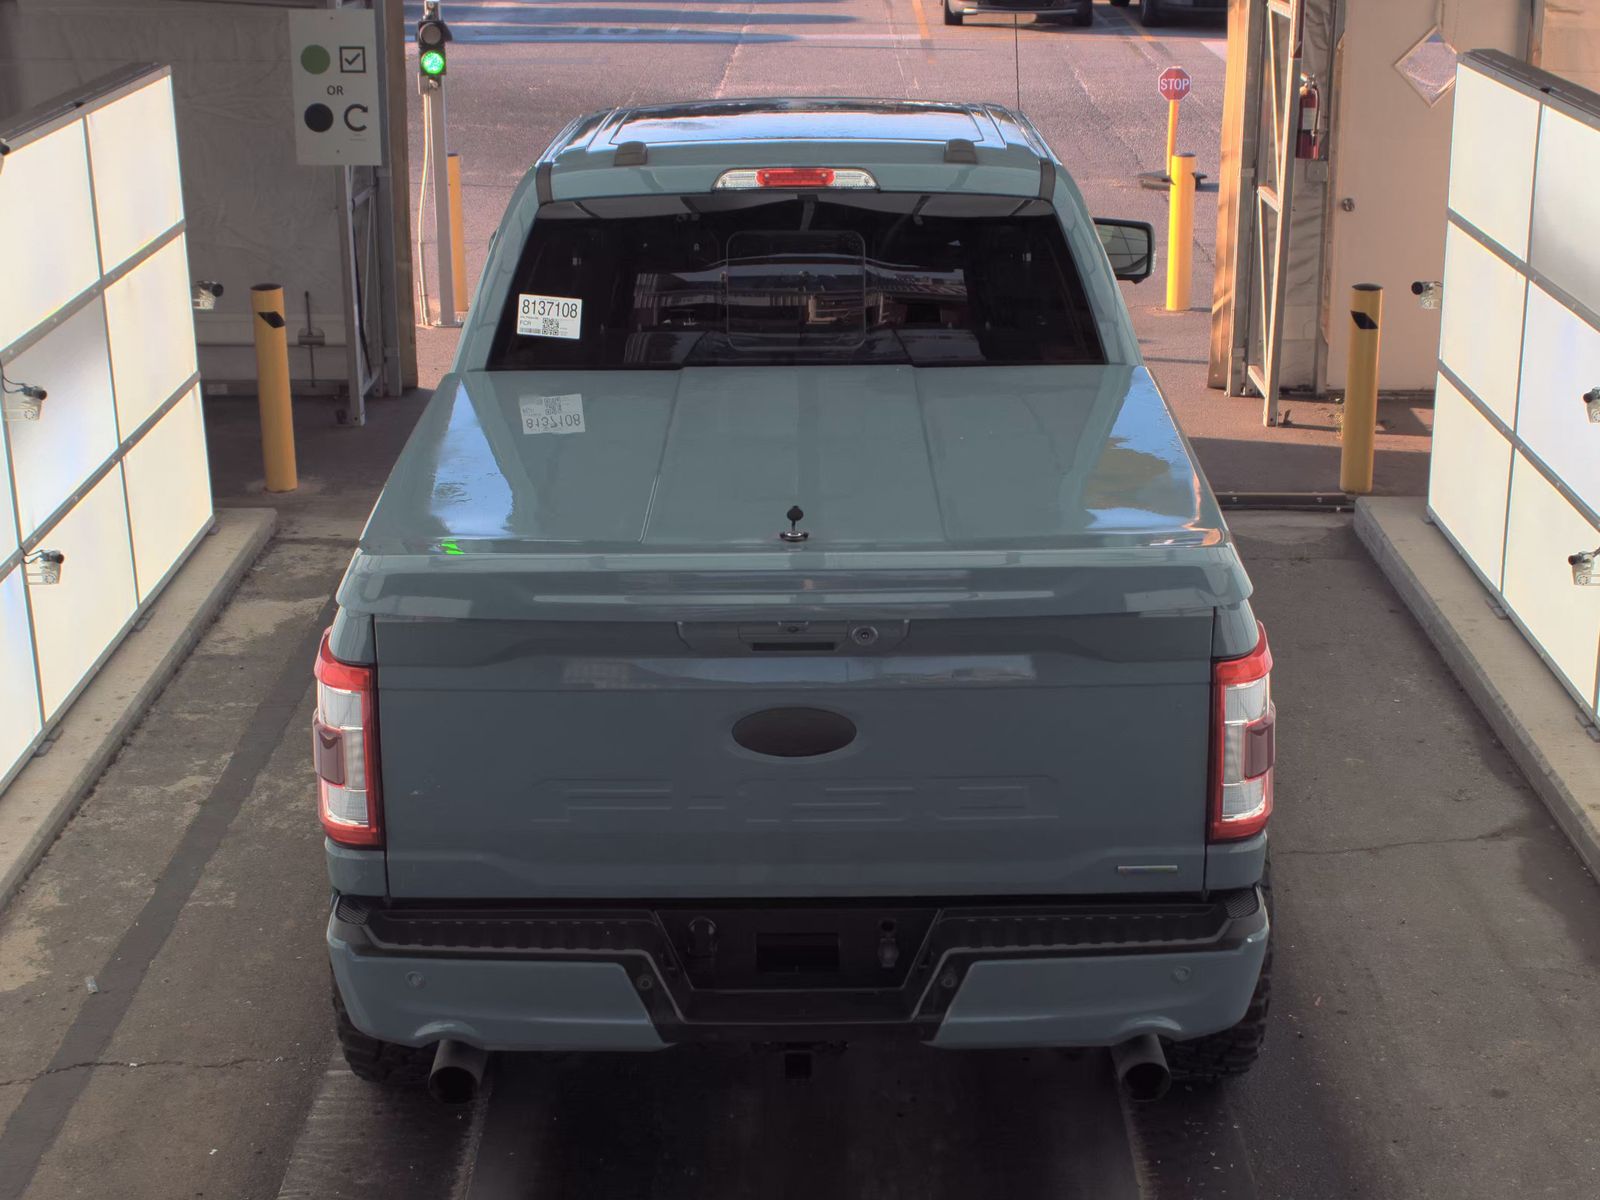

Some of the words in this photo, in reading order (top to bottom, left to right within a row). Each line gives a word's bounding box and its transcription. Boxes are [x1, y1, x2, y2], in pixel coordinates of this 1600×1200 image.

[326, 84, 344, 96] OR
[1160, 78, 1190, 91] STOP
[522, 299, 578, 318] 8137108
